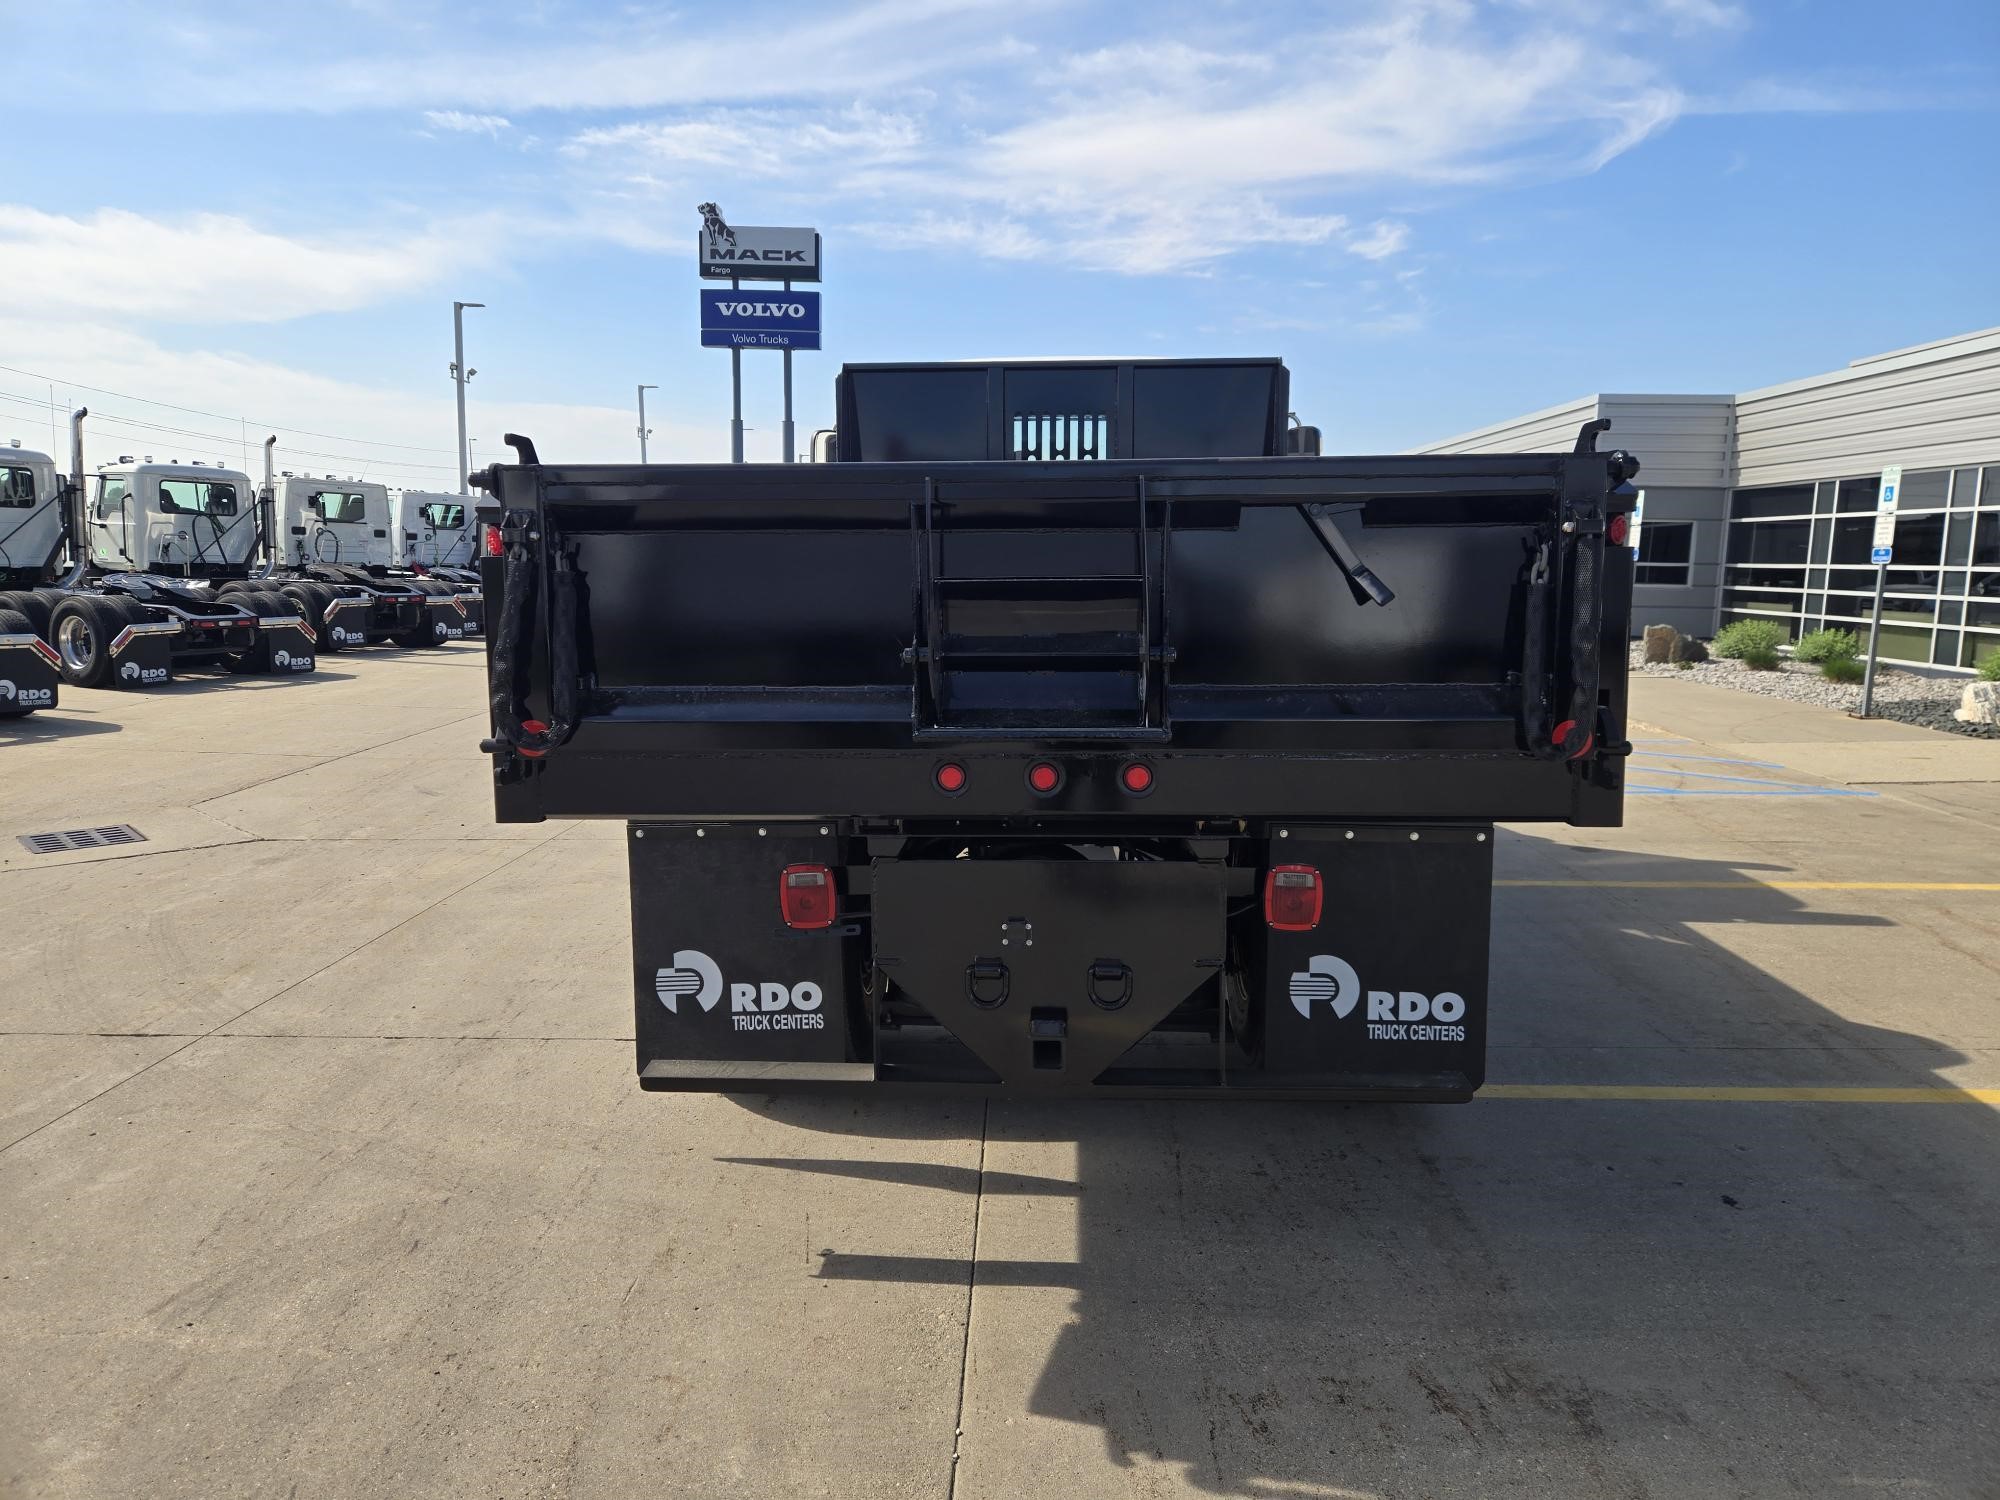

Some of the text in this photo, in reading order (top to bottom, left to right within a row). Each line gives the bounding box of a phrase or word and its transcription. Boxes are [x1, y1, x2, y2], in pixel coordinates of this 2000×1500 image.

[710, 249, 806, 262] MACK
[711, 266, 731, 275] Fargo
[715, 302, 805, 318] VOLVO
[732, 334, 789, 345] Volvo Trucks
[346, 632, 364, 640] RDO
[291, 657, 311, 666] RDO
[141, 668, 167, 679] RDO
[18, 688, 51, 700] RDO
[731, 981, 823, 1013] RDO
[1367, 991, 1466, 1022] RDO
[732, 1013, 824, 1031] TRUCK CENTERS
[1367, 1024, 1465, 1041] TRUCK CENTERS
